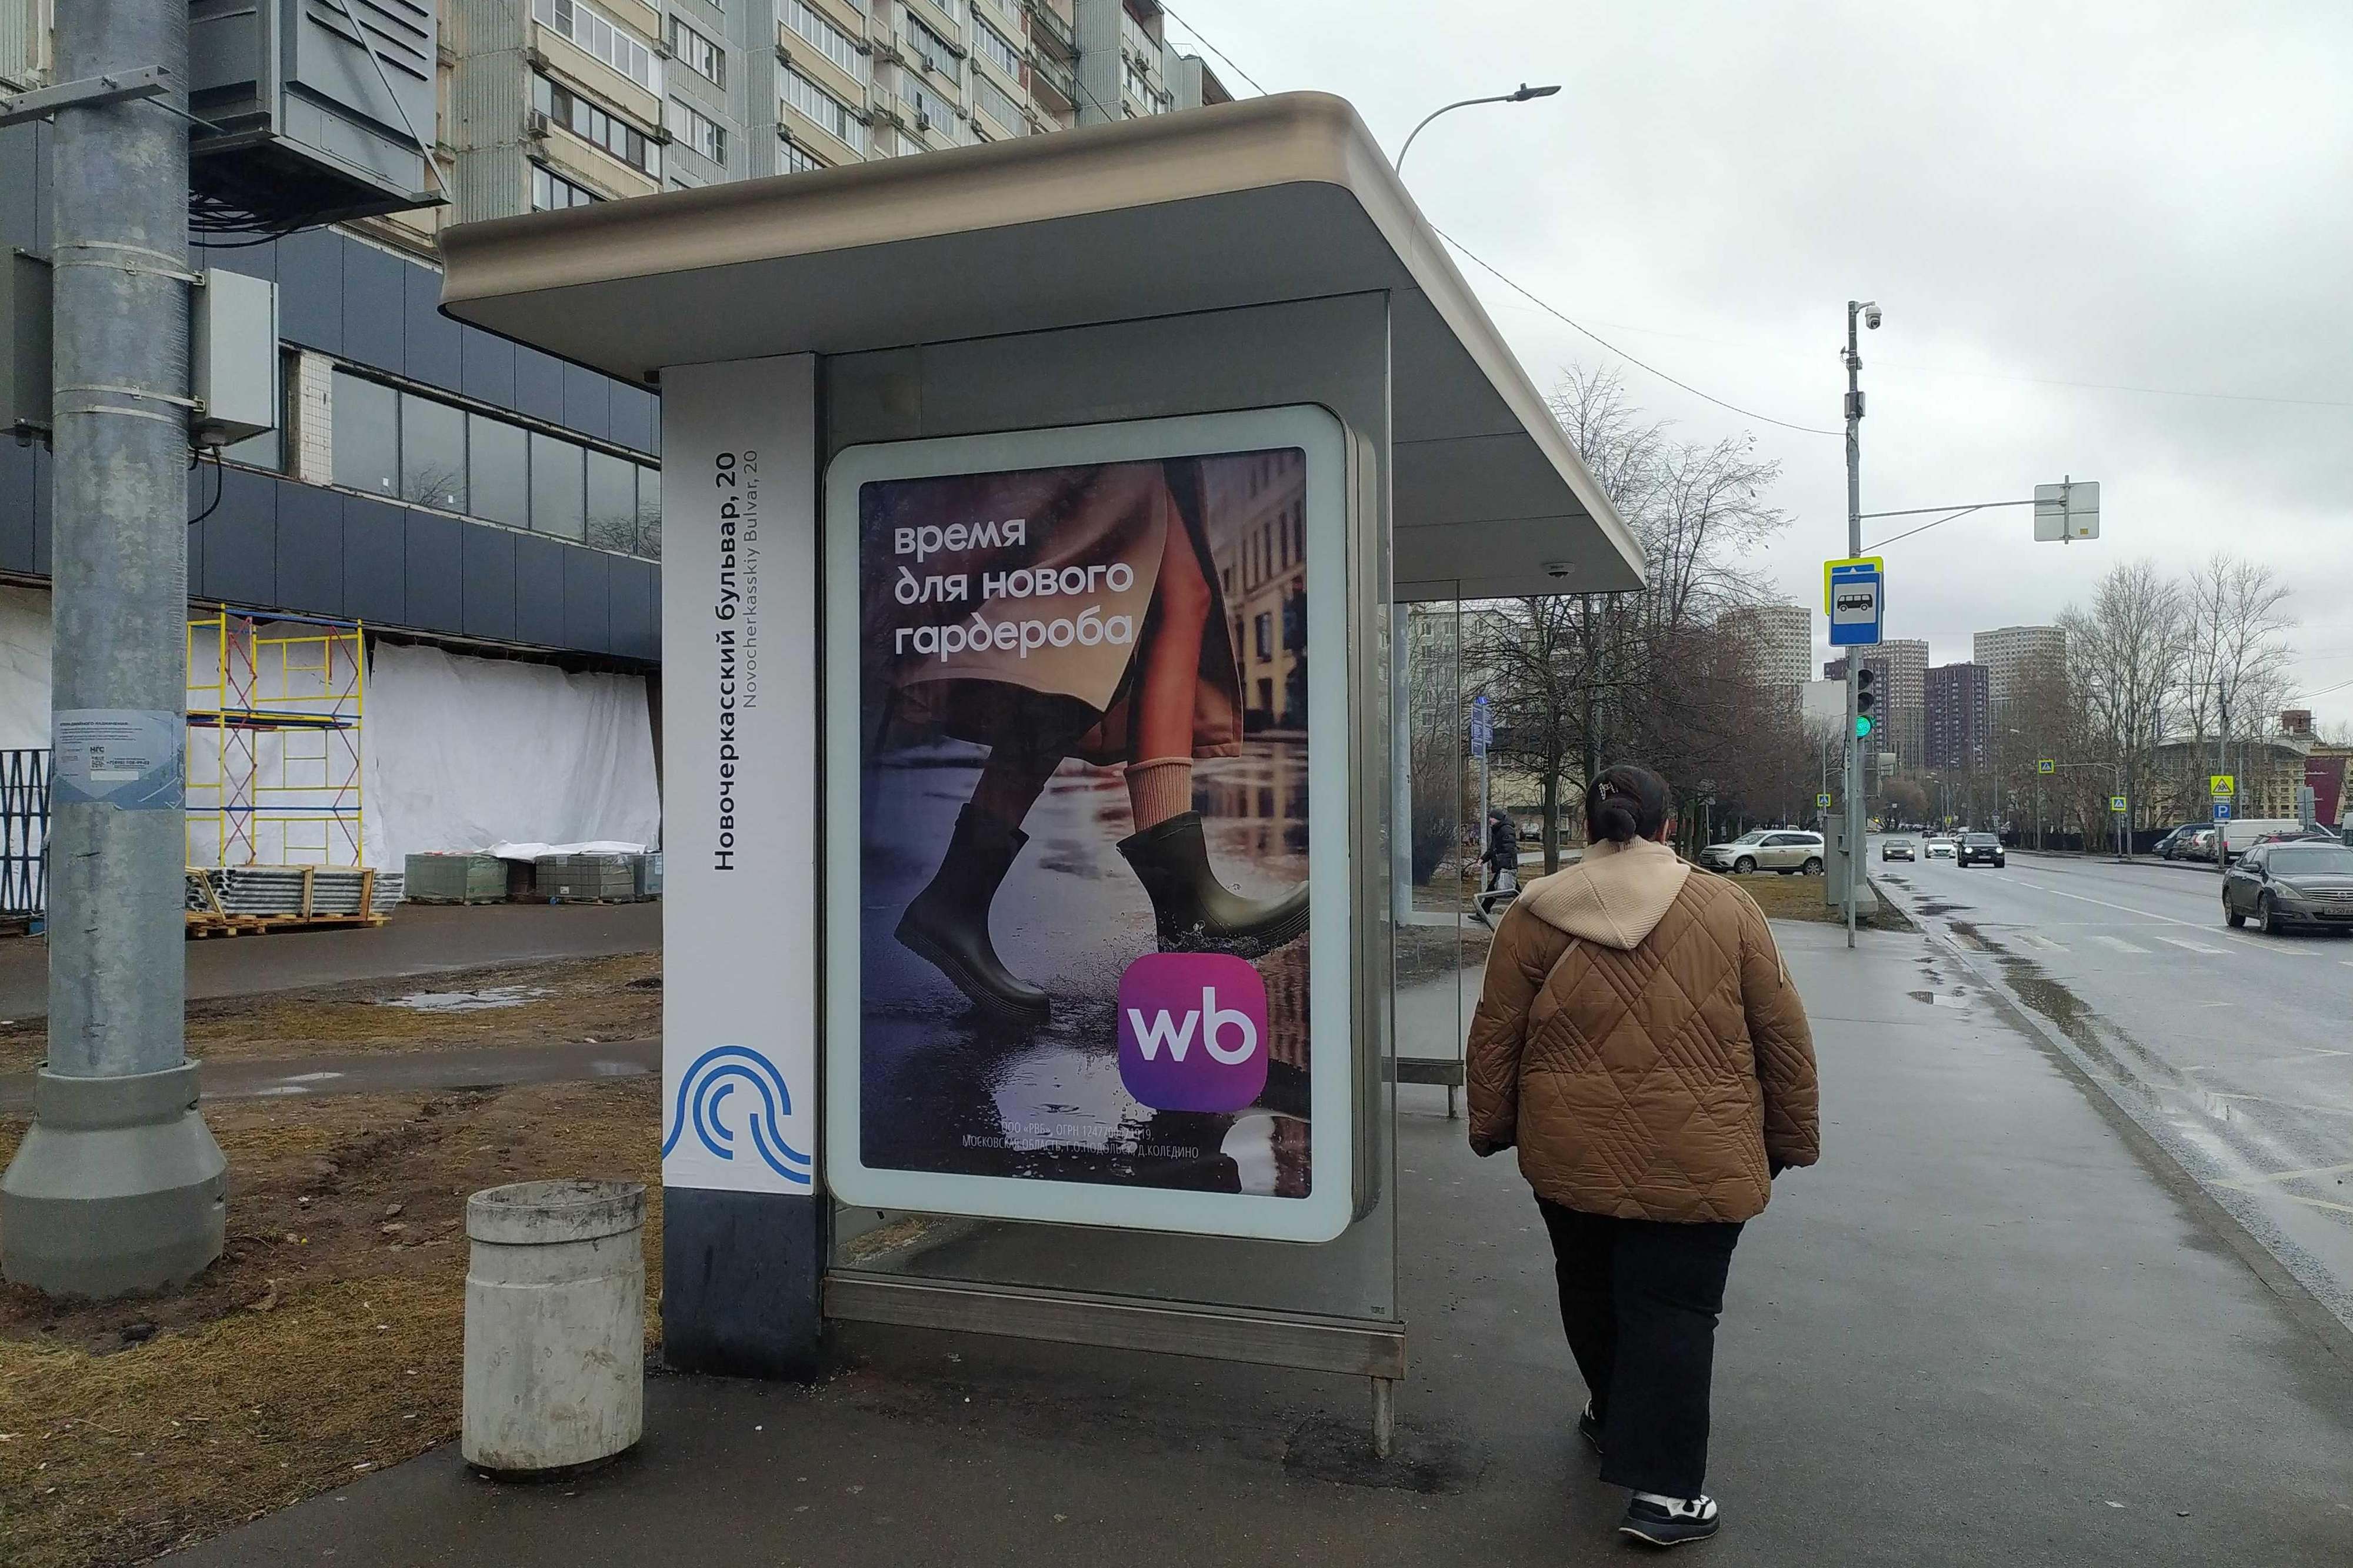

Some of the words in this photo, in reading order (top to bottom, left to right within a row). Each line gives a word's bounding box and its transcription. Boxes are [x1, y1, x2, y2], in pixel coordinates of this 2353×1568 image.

[715, 452, 736, 488] 20
[744, 449, 758, 475] 20
[743, 479, 761, 542] Bulvar,
[714, 495, 741, 621] бульвар,
[894, 518, 1026, 563] время
[894, 566, 968, 605] для
[983, 562, 1135, 600] нового
[743, 547, 761, 709] Novocherkasskiy
[895, 605, 1133, 663] гардероба
[714, 628, 739, 872] Новочеркасский
[1126, 986, 1257, 1065] wb
[961, 1135, 1020, 1150] МОСКОВСКАЯ
[1022, 1138, 1064, 1153] ОБЛАСТЬ,
[1001, 1122, 1021, 1134] ООО
[1056, 1124, 1079, 1136] ОГРН
